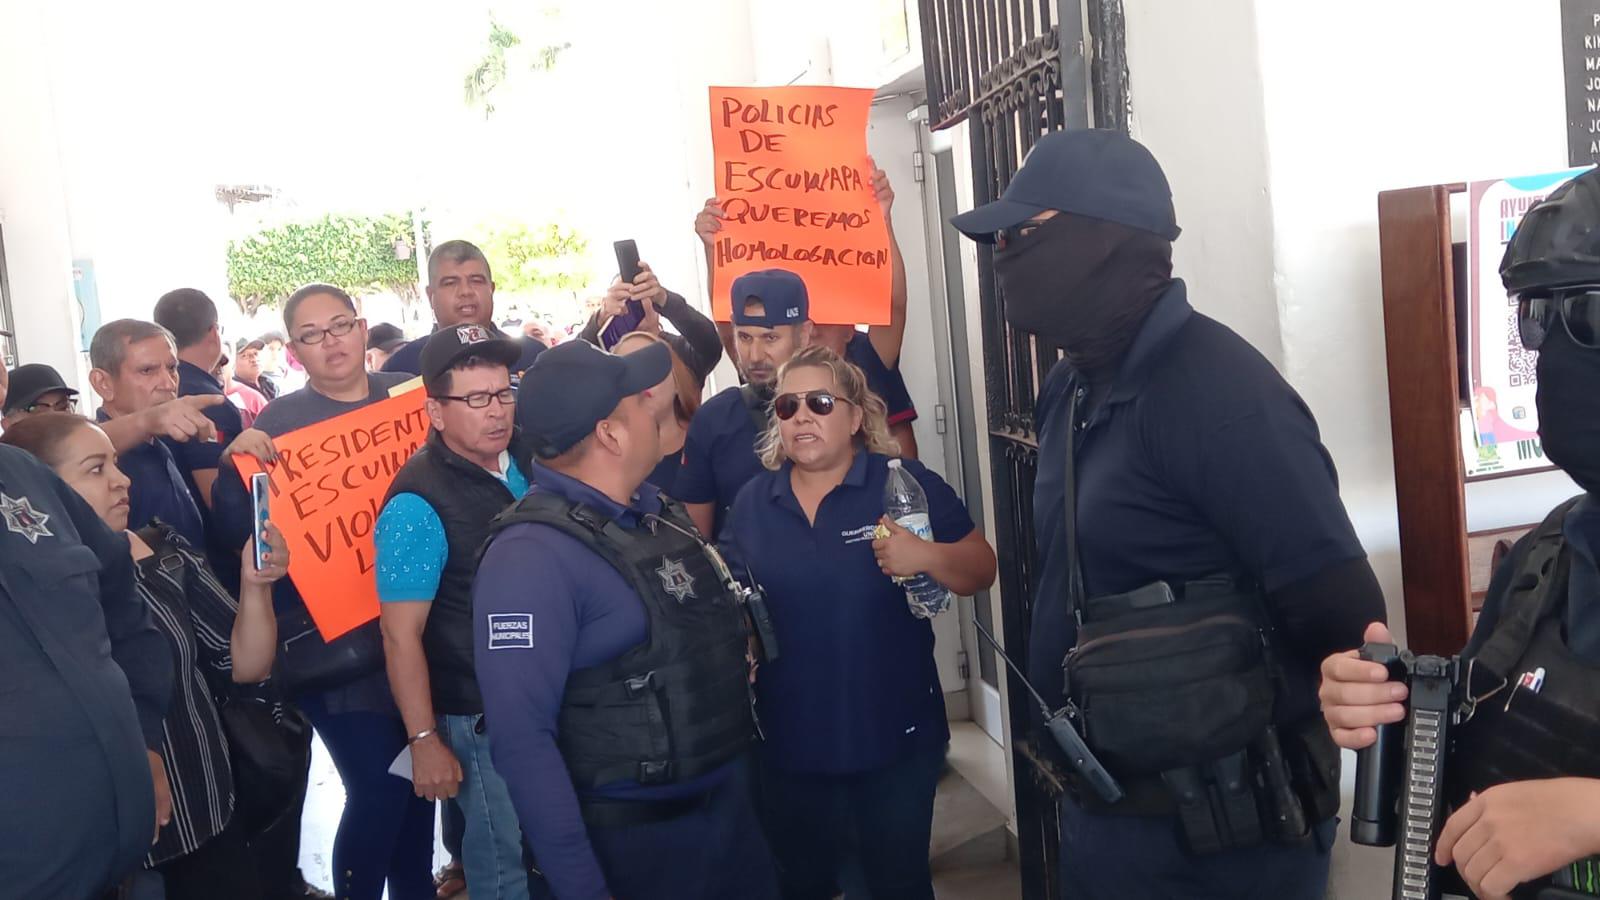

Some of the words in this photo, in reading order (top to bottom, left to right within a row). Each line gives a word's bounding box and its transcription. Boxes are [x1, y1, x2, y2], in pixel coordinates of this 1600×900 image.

[722, 97, 839, 128] POLICIAS
[739, 129, 787, 153] DE
[717, 198, 871, 231] QUEREMOS
[716, 238, 888, 268] HOMOLOGACION
[491, 631, 532, 641] MUNICIPALES
[493, 621, 528, 630] FUERZAS
